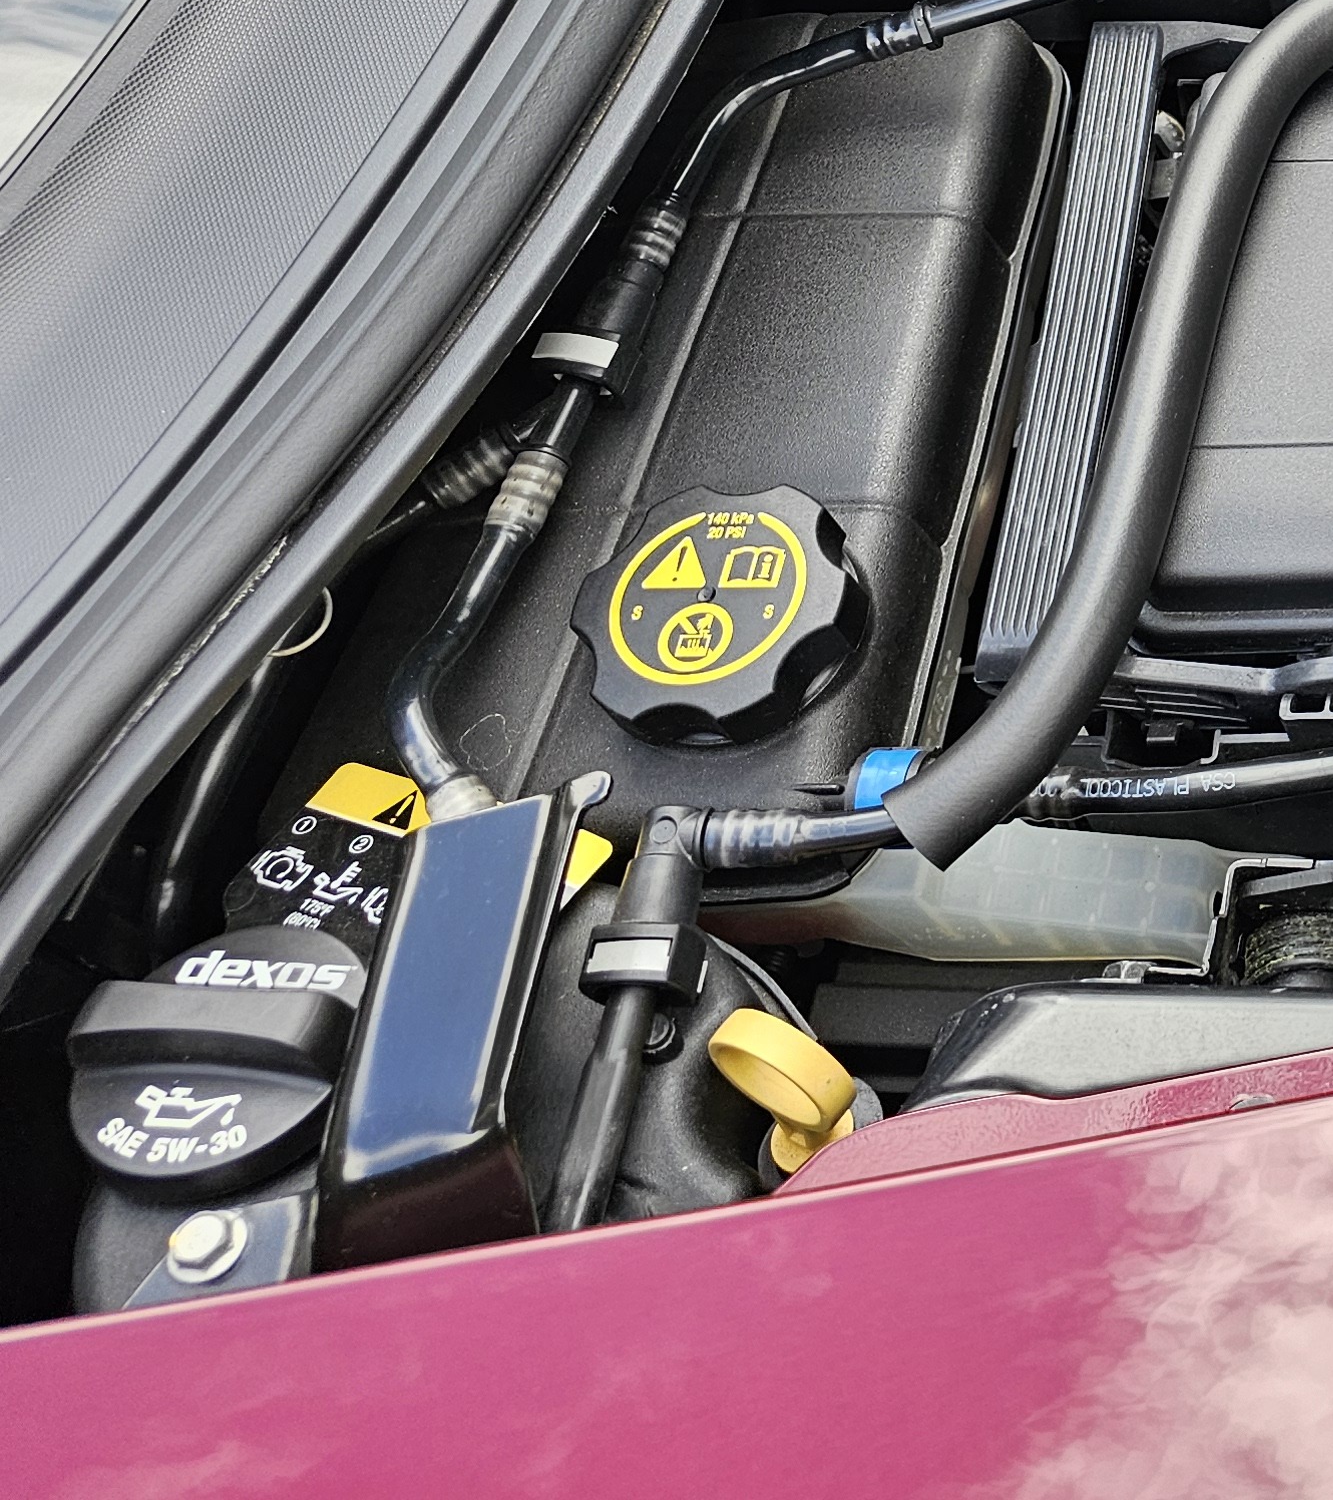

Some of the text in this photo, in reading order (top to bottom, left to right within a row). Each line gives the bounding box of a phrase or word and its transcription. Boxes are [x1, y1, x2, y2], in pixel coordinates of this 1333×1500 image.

[706, 512, 755, 526] 140 kPa
[706, 526, 747, 540] 20 PSI
[631, 604, 644, 622] S
[762, 604, 776, 621] S
[1080, 775, 1191, 799] PLASTICOOL
[1203, 771, 1236, 794] CSA
[175, 949, 352, 991] dexos
[97, 1117, 248, 1163] SAE 5W-30
